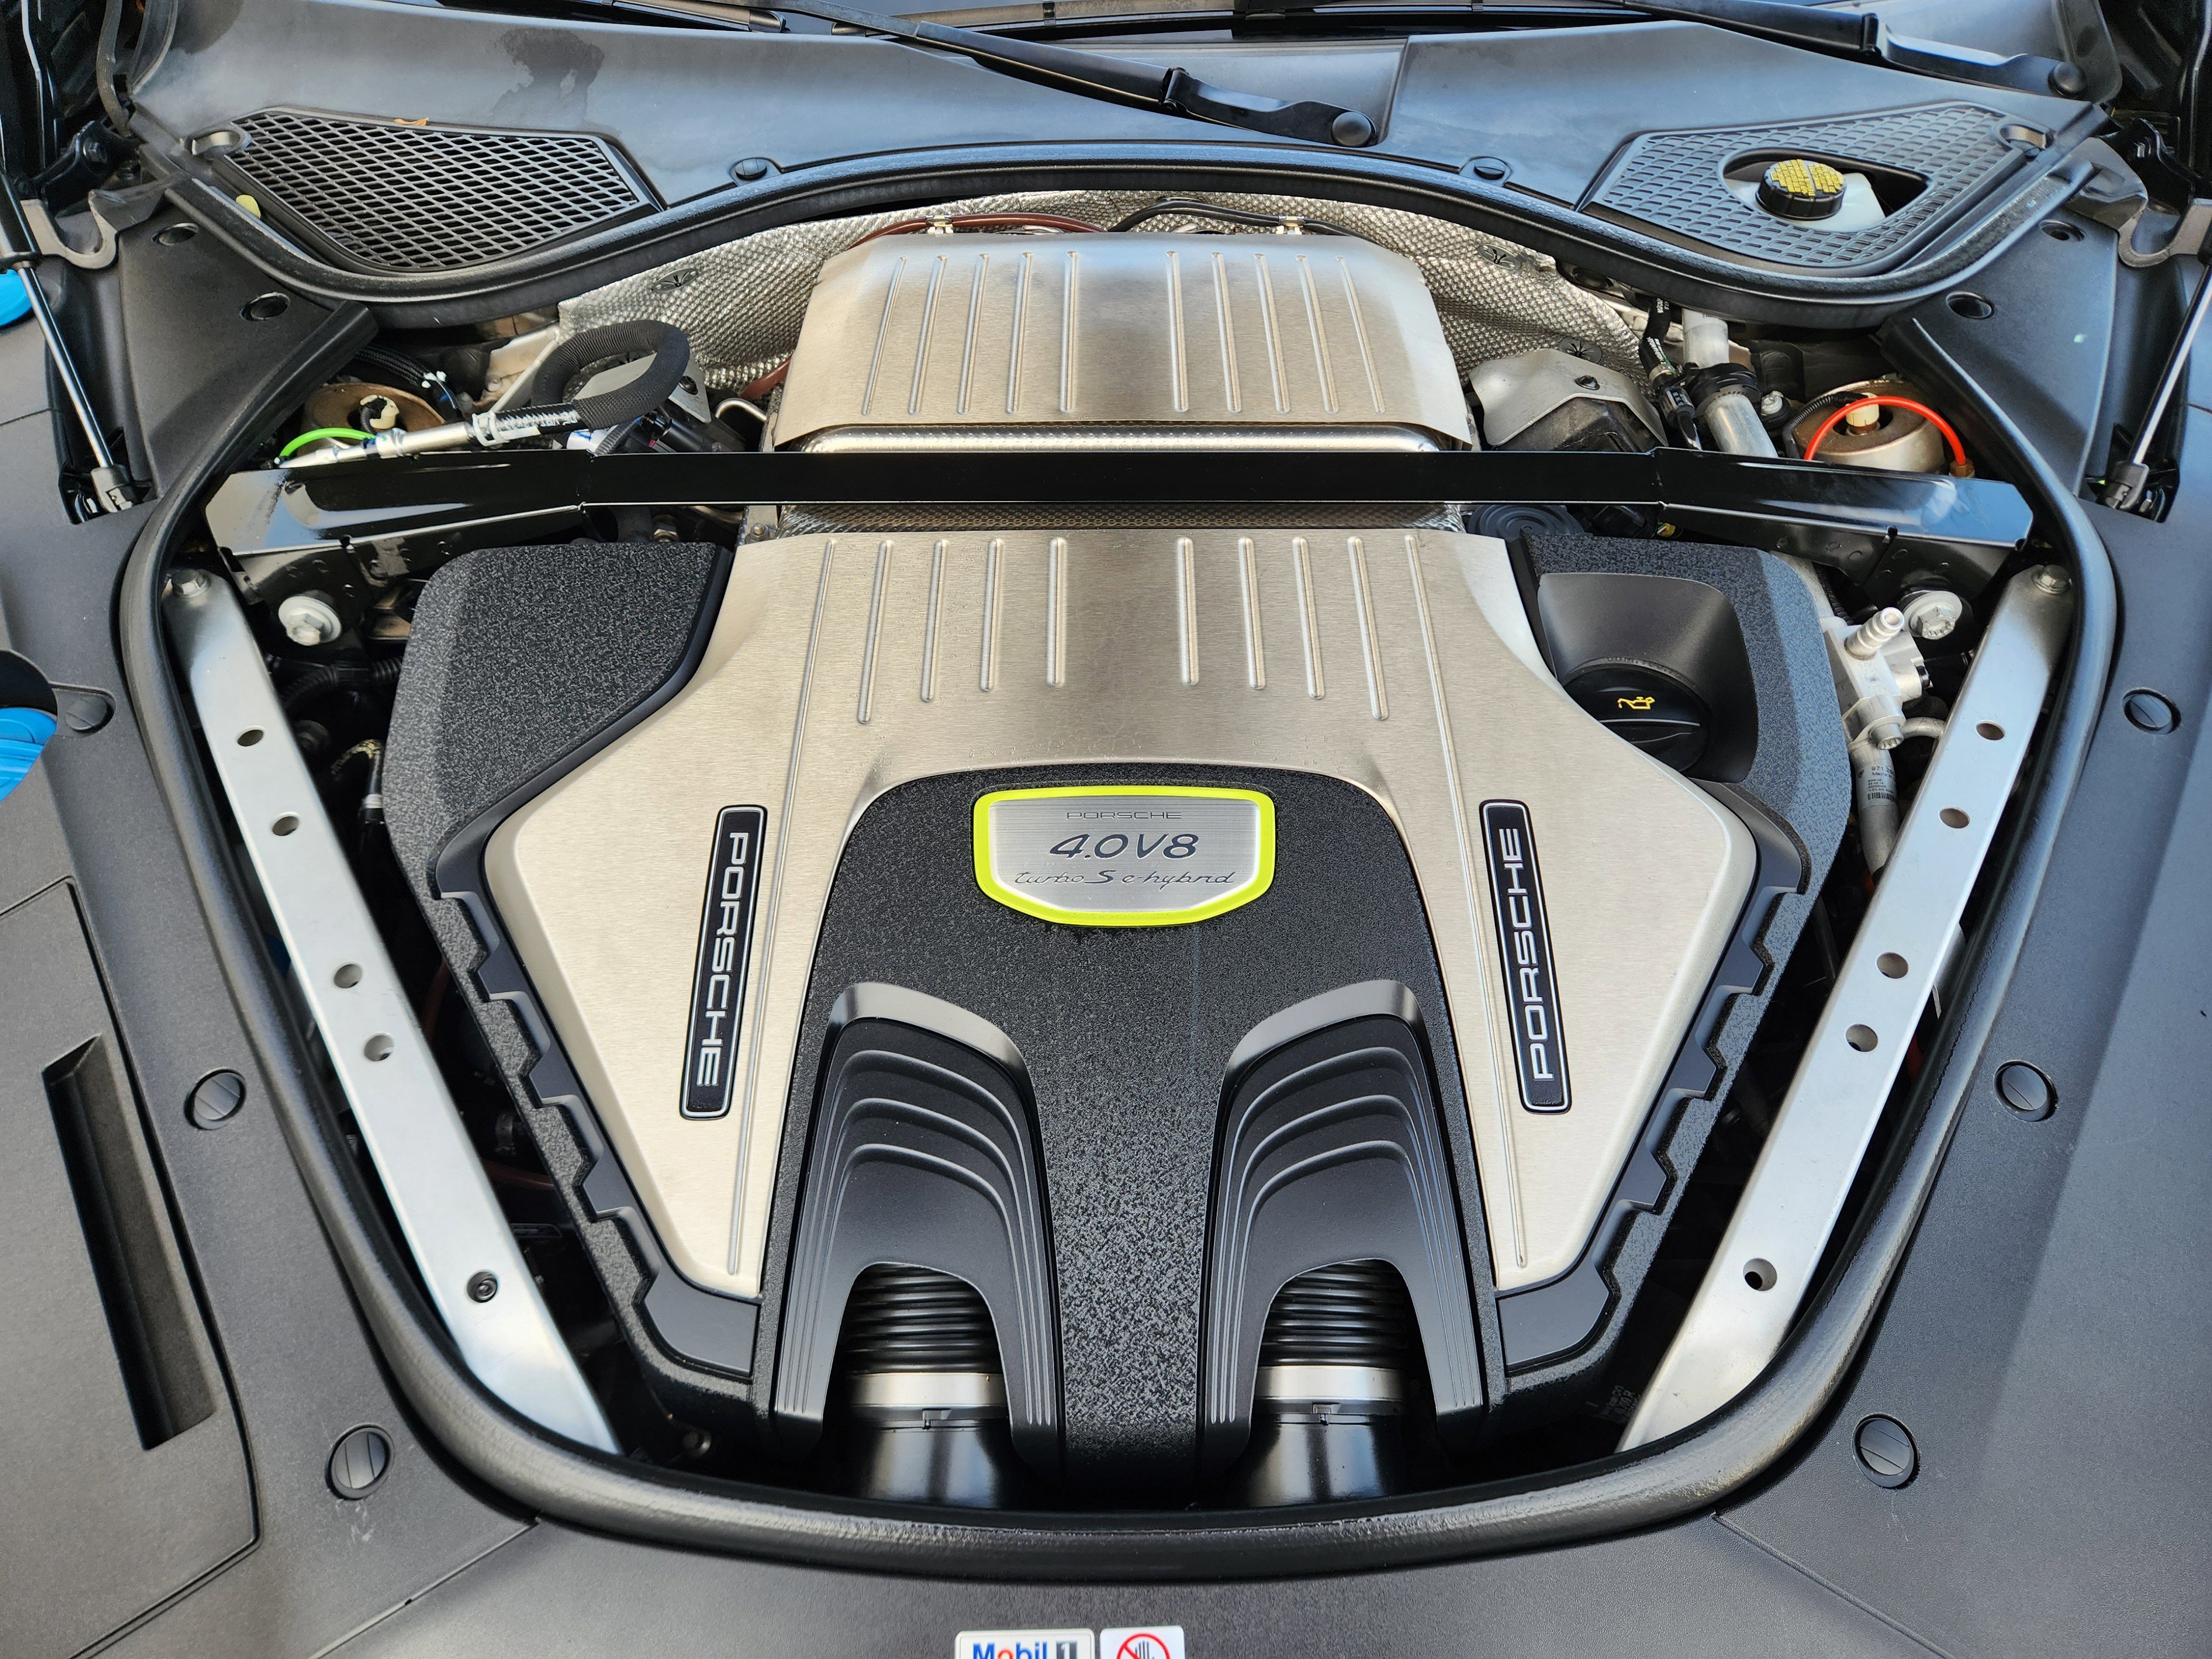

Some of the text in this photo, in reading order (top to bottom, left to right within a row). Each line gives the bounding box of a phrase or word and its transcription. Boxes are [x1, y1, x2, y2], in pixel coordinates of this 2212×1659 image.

[696, 832, 749, 1087] PORSCHE
[1014, 869, 1237, 891] turbo S e-hybrid
[1499, 828, 1554, 1081] PORSCHE
